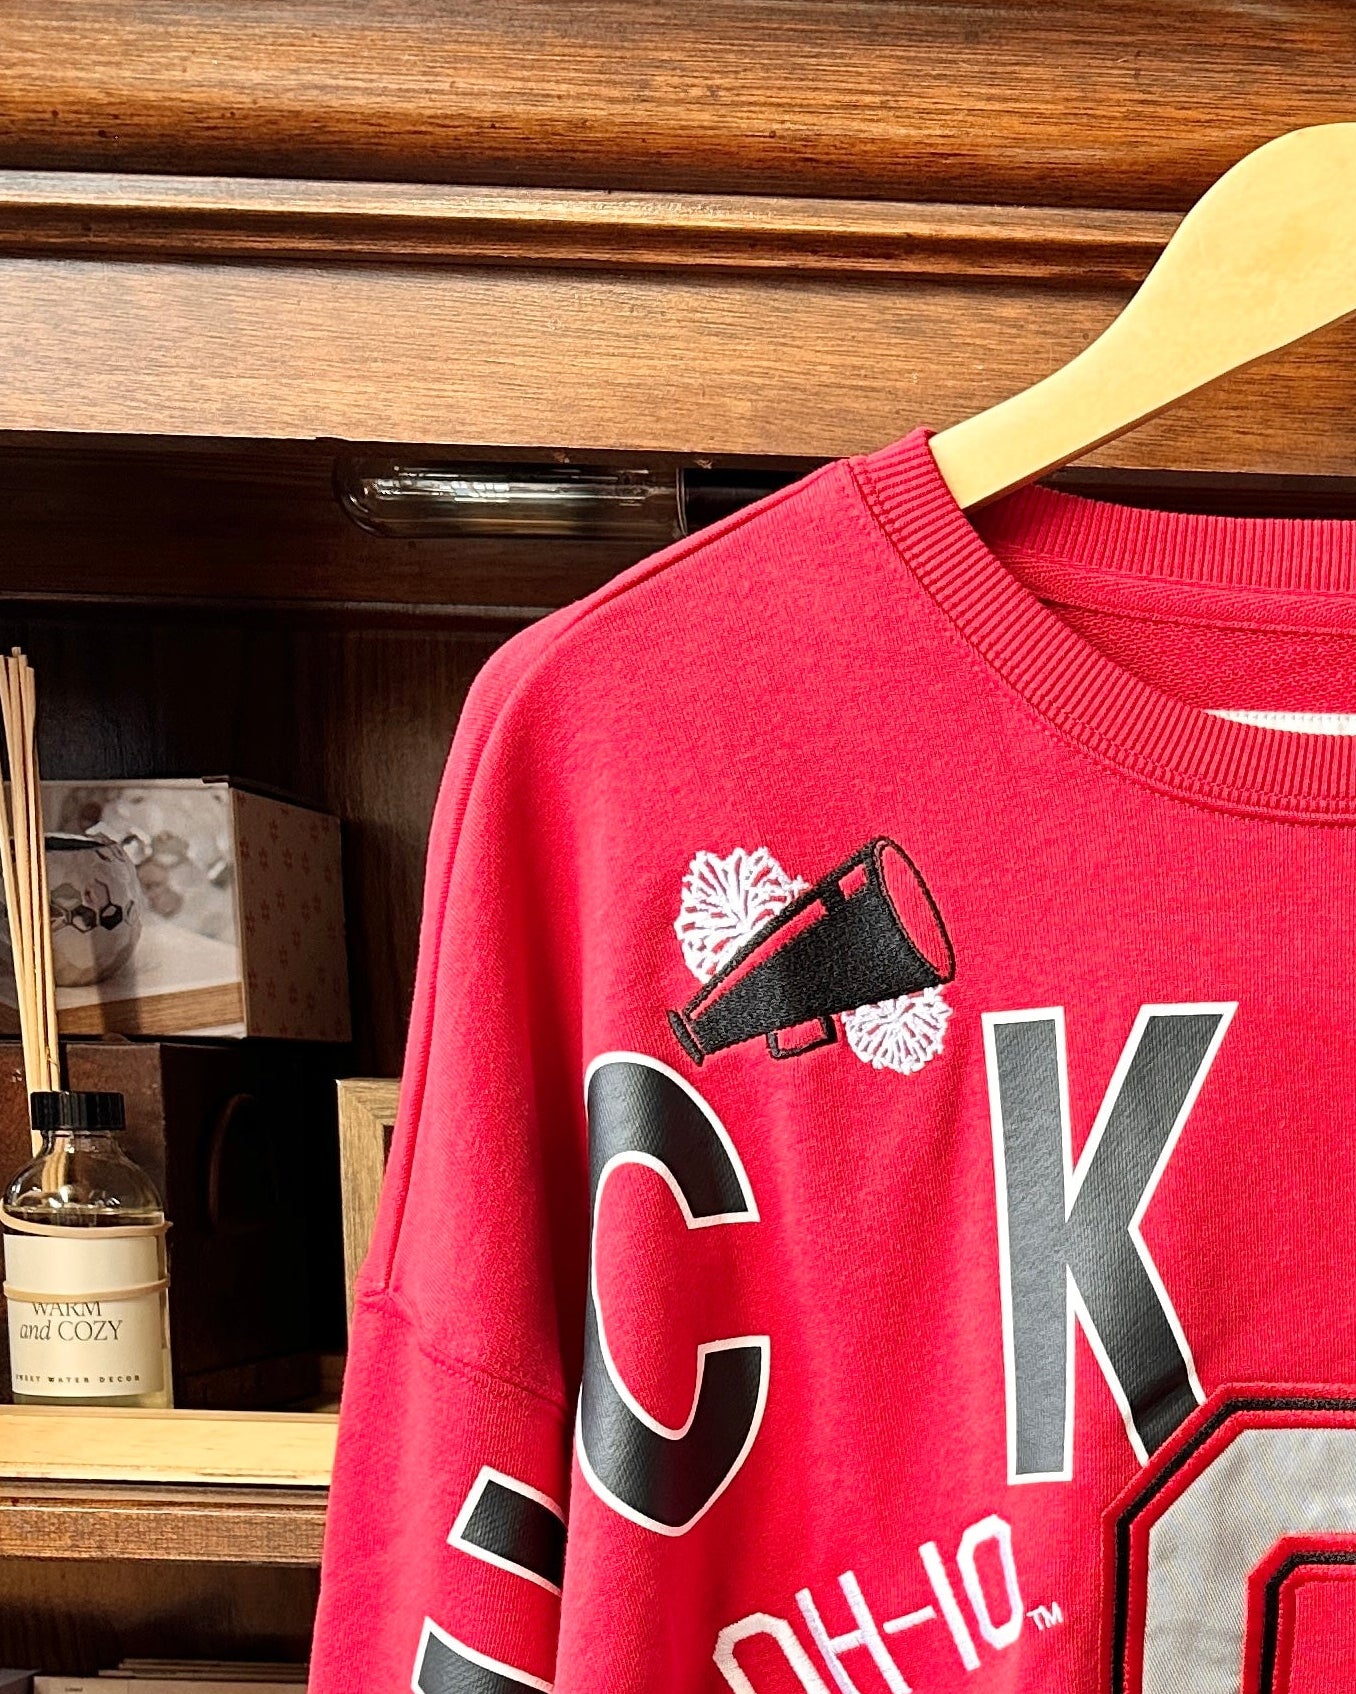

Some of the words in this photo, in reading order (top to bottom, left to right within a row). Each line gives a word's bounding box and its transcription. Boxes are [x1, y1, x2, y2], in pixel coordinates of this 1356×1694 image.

[32, 1301, 102, 1317] WARM
[20, 1320, 51, 1340] and
[58, 1320, 123, 1341] COZY
[99, 1374, 140, 1383] DECOR
